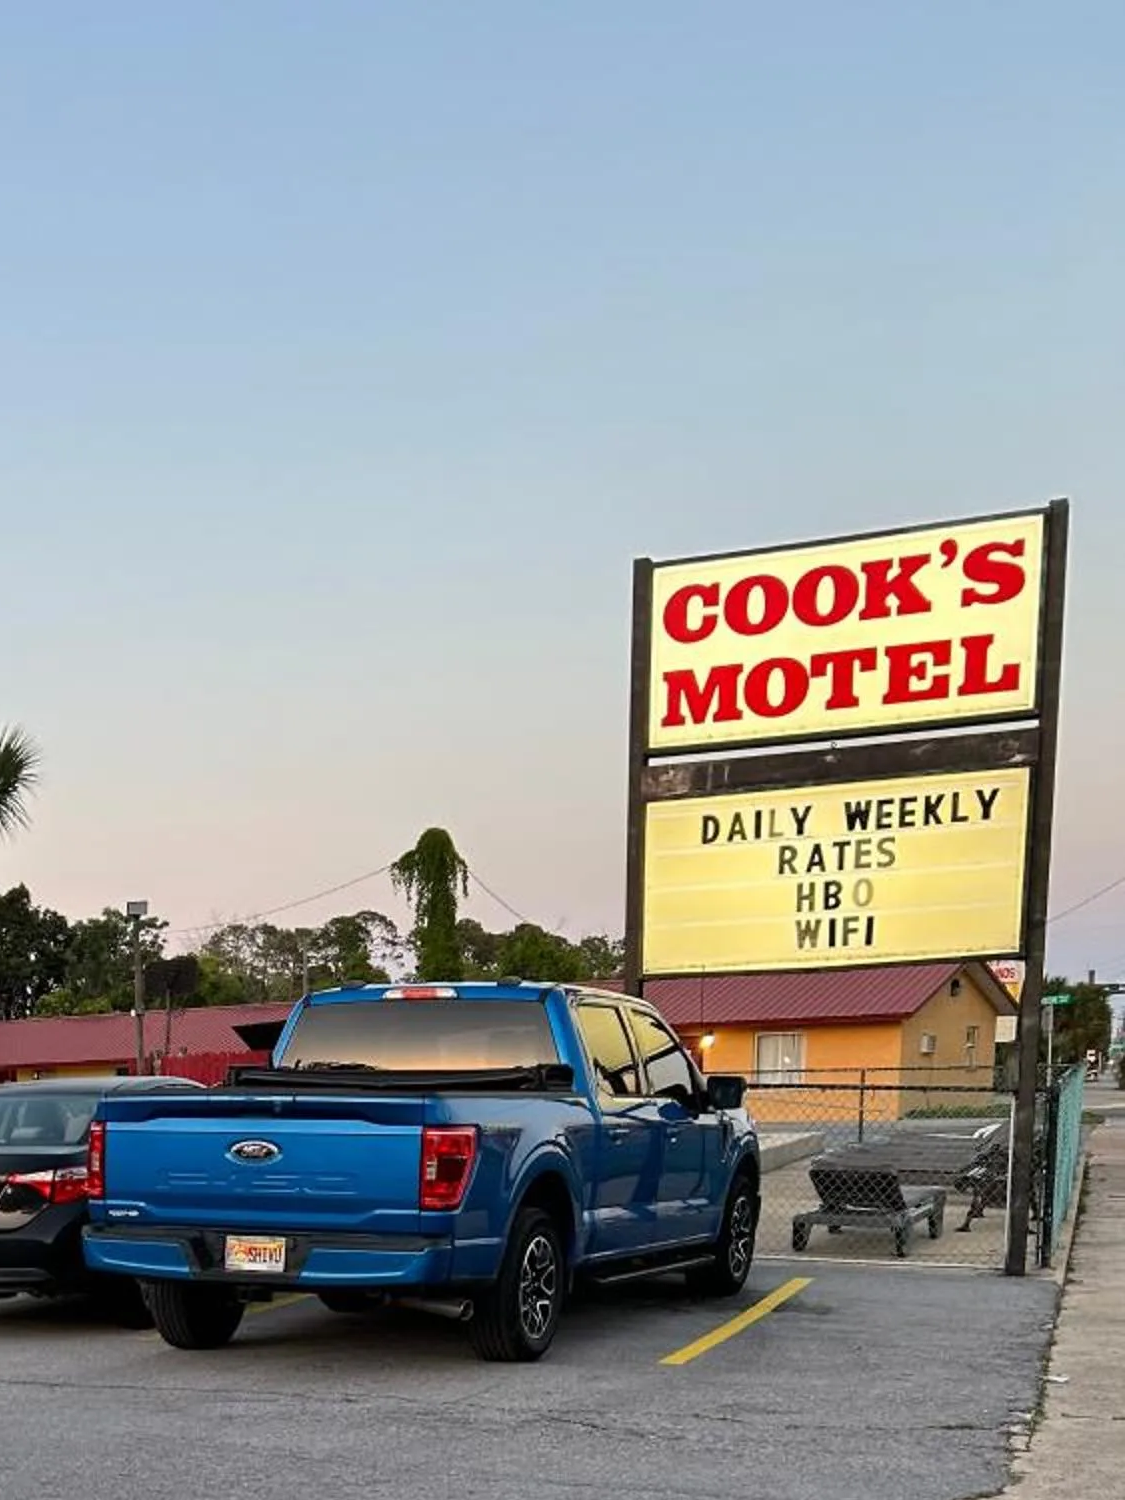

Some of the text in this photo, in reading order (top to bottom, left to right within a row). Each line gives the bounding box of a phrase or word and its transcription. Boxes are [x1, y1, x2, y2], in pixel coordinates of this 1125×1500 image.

[662, 538, 1026, 645] COOK'S
[661, 633, 1021, 728] MOTEL
[701, 787, 1001, 845] DAILY WEEKLY
[778, 836, 896, 876] RATES
[795, 878, 874, 913] HBO
[795, 915, 875, 950] WIFI
